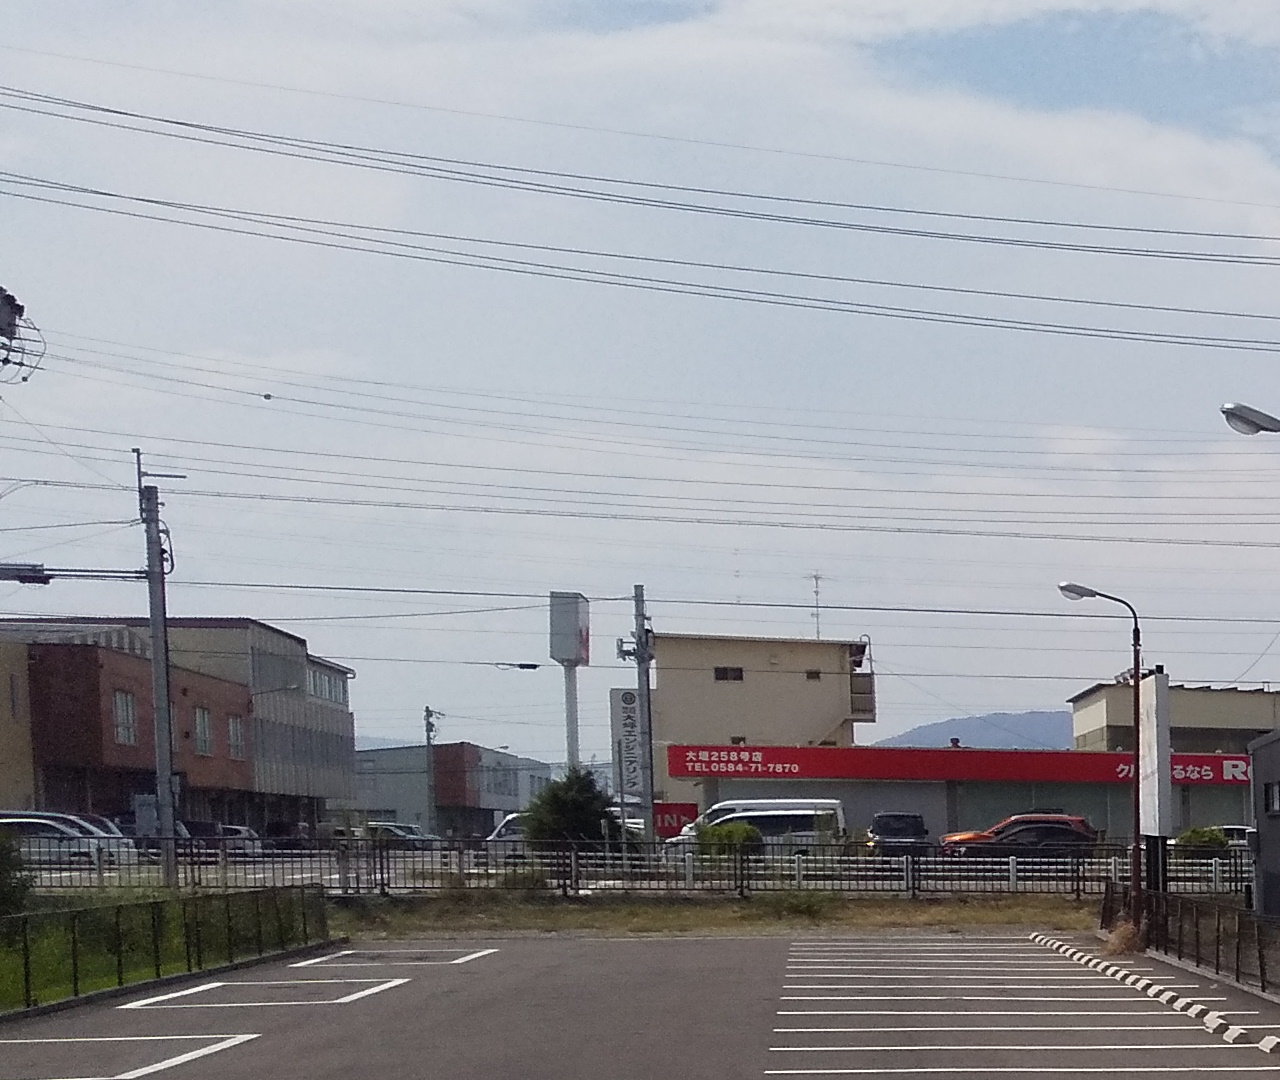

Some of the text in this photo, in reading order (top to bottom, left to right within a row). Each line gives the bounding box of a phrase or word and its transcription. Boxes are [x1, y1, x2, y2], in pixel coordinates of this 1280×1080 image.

[686, 751, 763, 762] 大垣258号店
[1222, 760, 1251, 781] R
